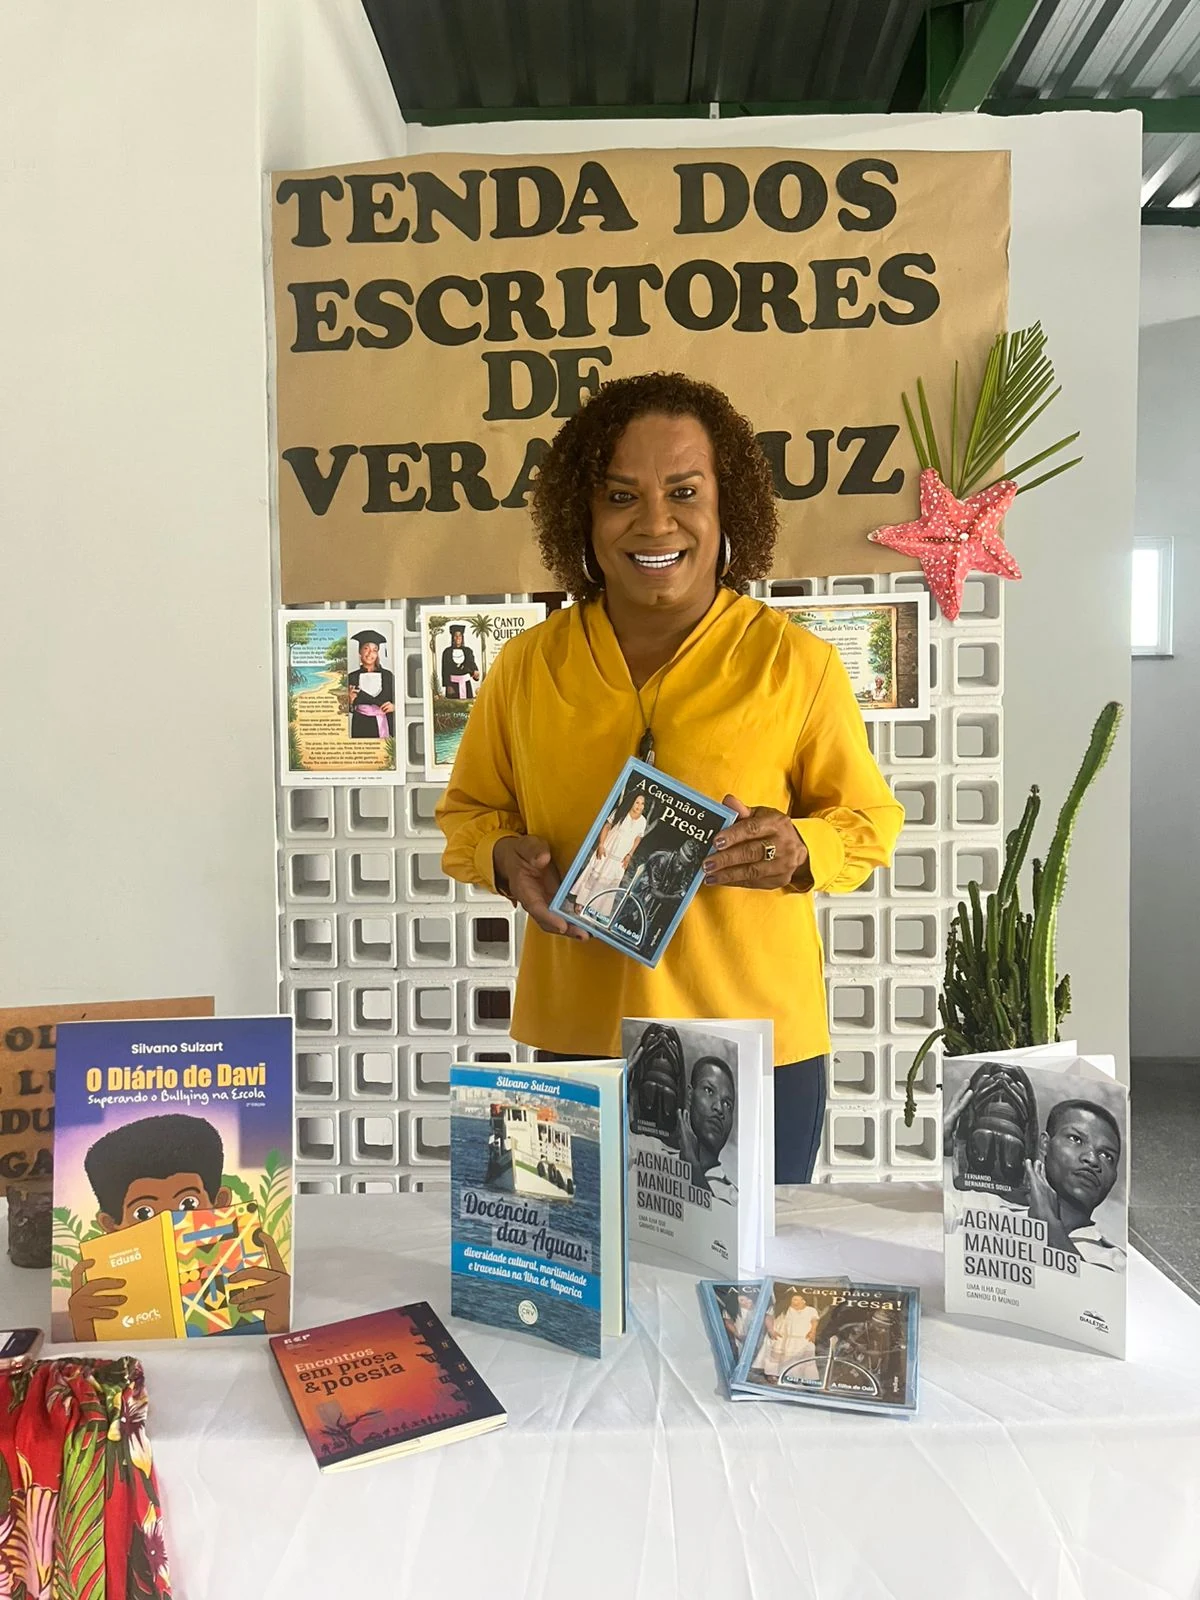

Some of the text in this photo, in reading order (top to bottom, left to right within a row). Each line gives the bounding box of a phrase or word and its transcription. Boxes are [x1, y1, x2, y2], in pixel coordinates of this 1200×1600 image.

[276, 158, 899, 248] TENDA DOS
[288, 252, 941, 353] ESCRITORES
[755, 424, 905, 501] UZ
[494, 616, 525, 630] CANTO
[636, 779, 706, 820] A Caça não é
[660, 806, 714, 844] Presa!
[131, 1042, 224, 1054] Silvano Sulzart
[86, 1062, 266, 1092] O Diário de Davi
[496, 1076, 560, 1096] Silvano Sulzart
[88, 1092, 148, 1108] Superando
[161, 1090, 209, 1106] Bullying
[212, 1092, 228, 1100] na
[231, 1087, 266, 1100] Escola
[637, 1151, 690, 1180] AGNALDO
[964, 1173, 992, 1182] FERNANDO
[638, 1171, 711, 1209] MANUEL DOS
[464, 1192, 540, 1226] Docência
[638, 1192, 682, 1219] SANTOS
[496, 1221, 528, 1246] das
[964, 1210, 1045, 1241] AGNALDO
[464, 1246, 507, 1264] diversidade
[508, 1256, 538, 1272] cultural,
[965, 1232, 1077, 1274] MANUEL DOS
[474, 1262, 511, 1279] travessias
[512, 1270, 522, 1281] na
[540, 1276, 550, 1288] de
[965, 1256, 1032, 1286] SANTOS
[802, 1287, 838, 1296] Caça
[842, 1288, 870, 1298] não
[831, 1296, 902, 1311] Presa!
[982, 1285, 994, 1293] ILHA
[995, 1288, 1008, 1296] QUE
[295, 1348, 374, 1372] Encontros
[300, 1352, 398, 1382] em prosa
